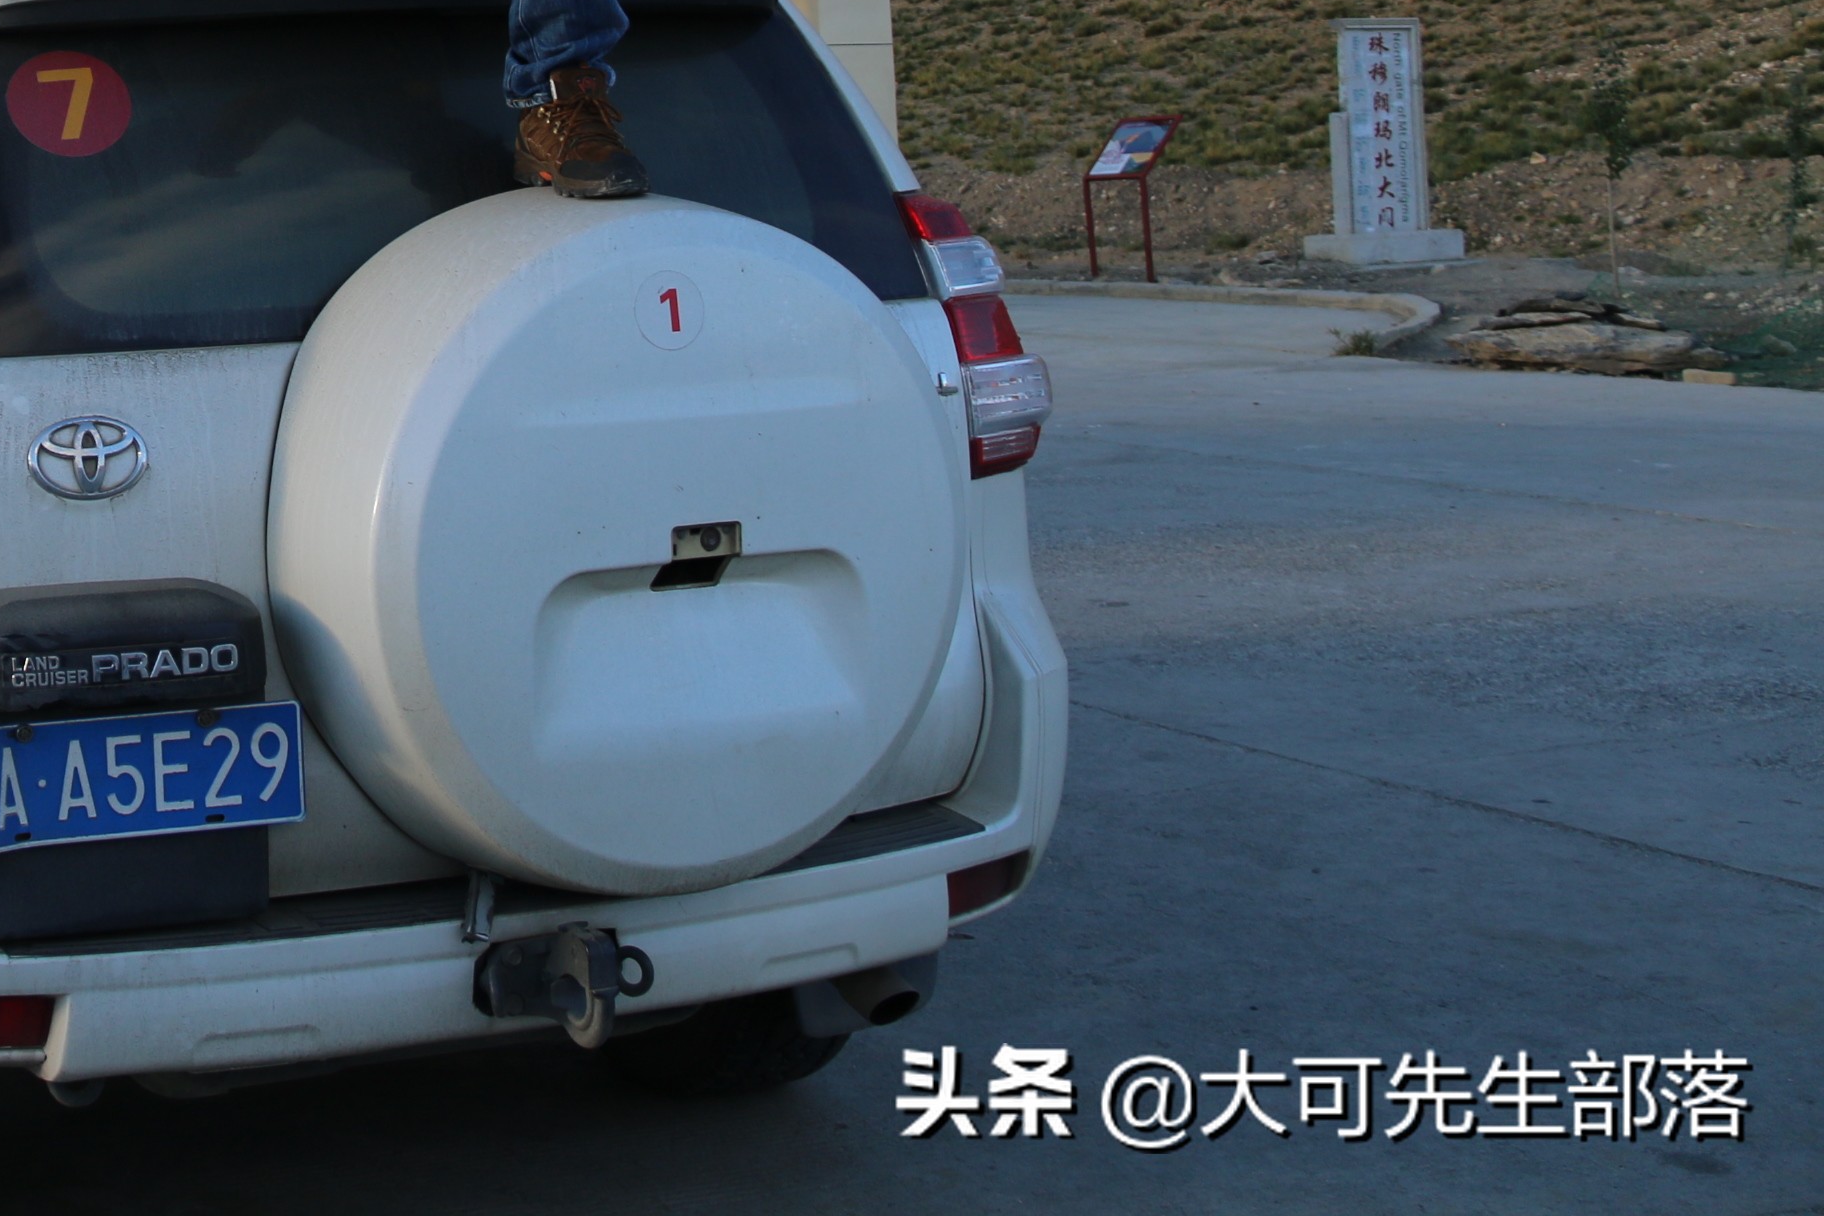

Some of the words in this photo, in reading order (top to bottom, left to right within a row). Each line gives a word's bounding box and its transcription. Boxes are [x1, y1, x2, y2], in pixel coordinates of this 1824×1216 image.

[1392, 32, 1403, 67] North
[1393, 72, 1405, 100] gate
[36, 67, 94, 141] 7
[1397, 106, 1407, 118] of
[1367, 32, 1396, 229] 珠穆朗玛北大门
[1397, 120, 1408, 136] Mt
[659, 288, 681, 332] 1
[11, 655, 60, 672] LAND
[11, 668, 89, 688] CRUISER
[91, 643, 239, 683] PRADO
